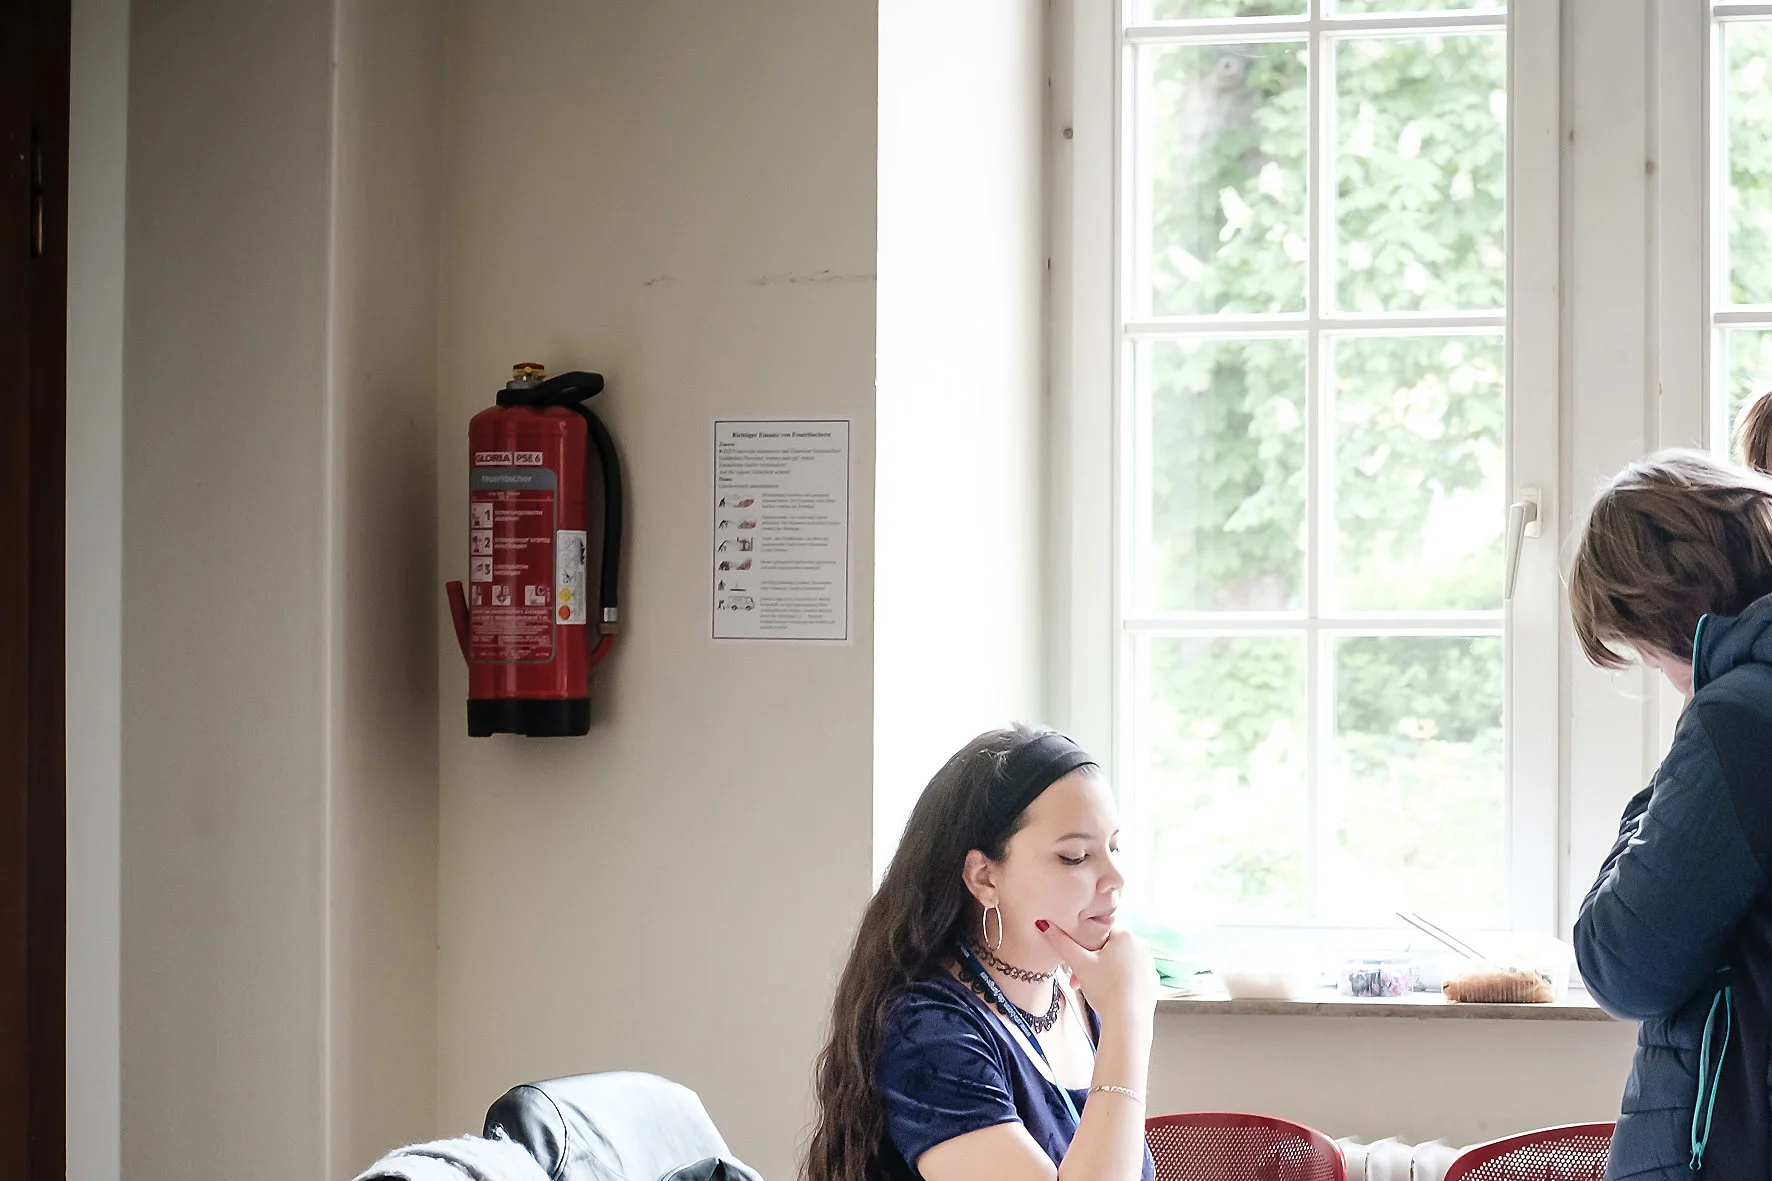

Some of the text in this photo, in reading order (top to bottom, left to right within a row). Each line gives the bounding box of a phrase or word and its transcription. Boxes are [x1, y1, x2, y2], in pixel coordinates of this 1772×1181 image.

[476, 454, 541, 463] GLORIA PSE 6
[485, 510, 490, 521] 1
[484, 537, 491, 548] 2
[484, 564, 490, 575] 3
